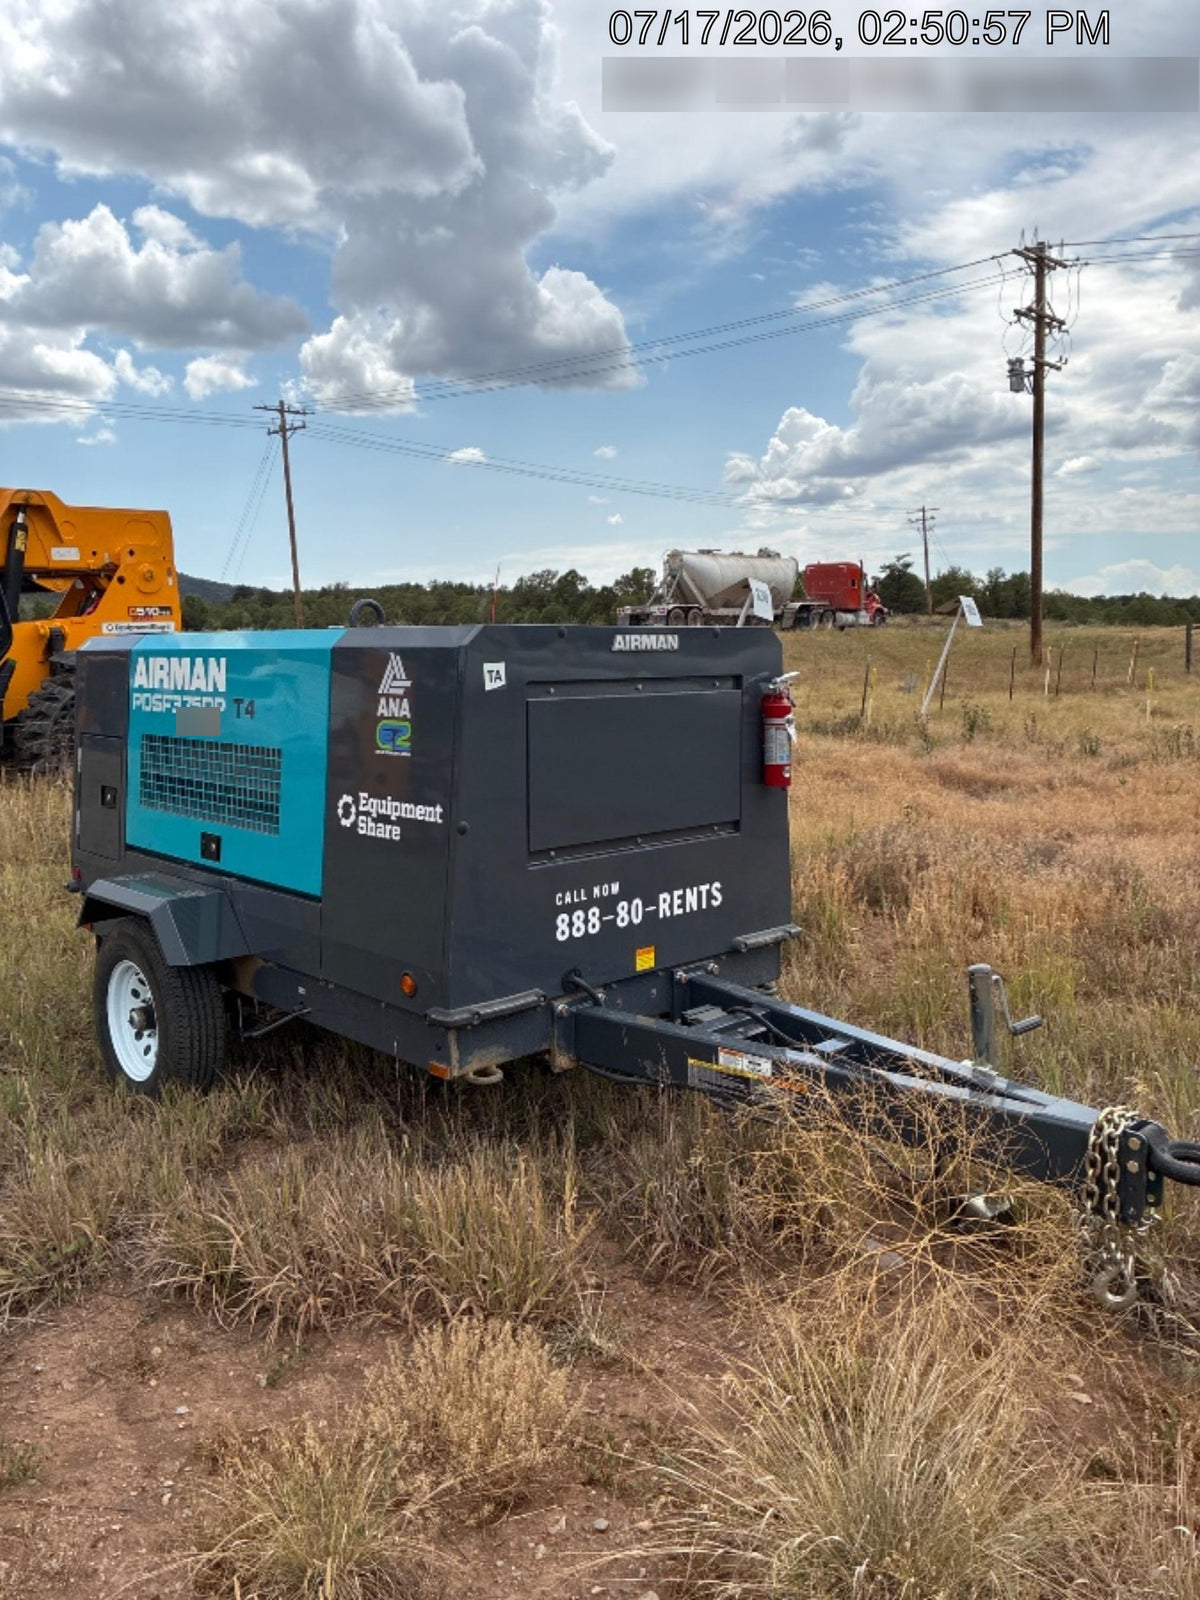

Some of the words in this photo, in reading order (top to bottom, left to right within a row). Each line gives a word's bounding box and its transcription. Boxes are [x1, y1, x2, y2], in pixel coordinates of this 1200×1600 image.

[612, 634, 679, 651] AIRMAN
[133, 657, 227, 692] AIRMAN
[487, 669, 503, 683] TA
[233, 698, 256, 720] T4
[377, 697, 411, 719] ANA
[358, 792, 443, 824] Equipment
[357, 815, 401, 841] Share
[555, 888, 588, 906] CALL
[593, 881, 620, 899] NOW
[555, 881, 723, 942] 888-80-RENTS
